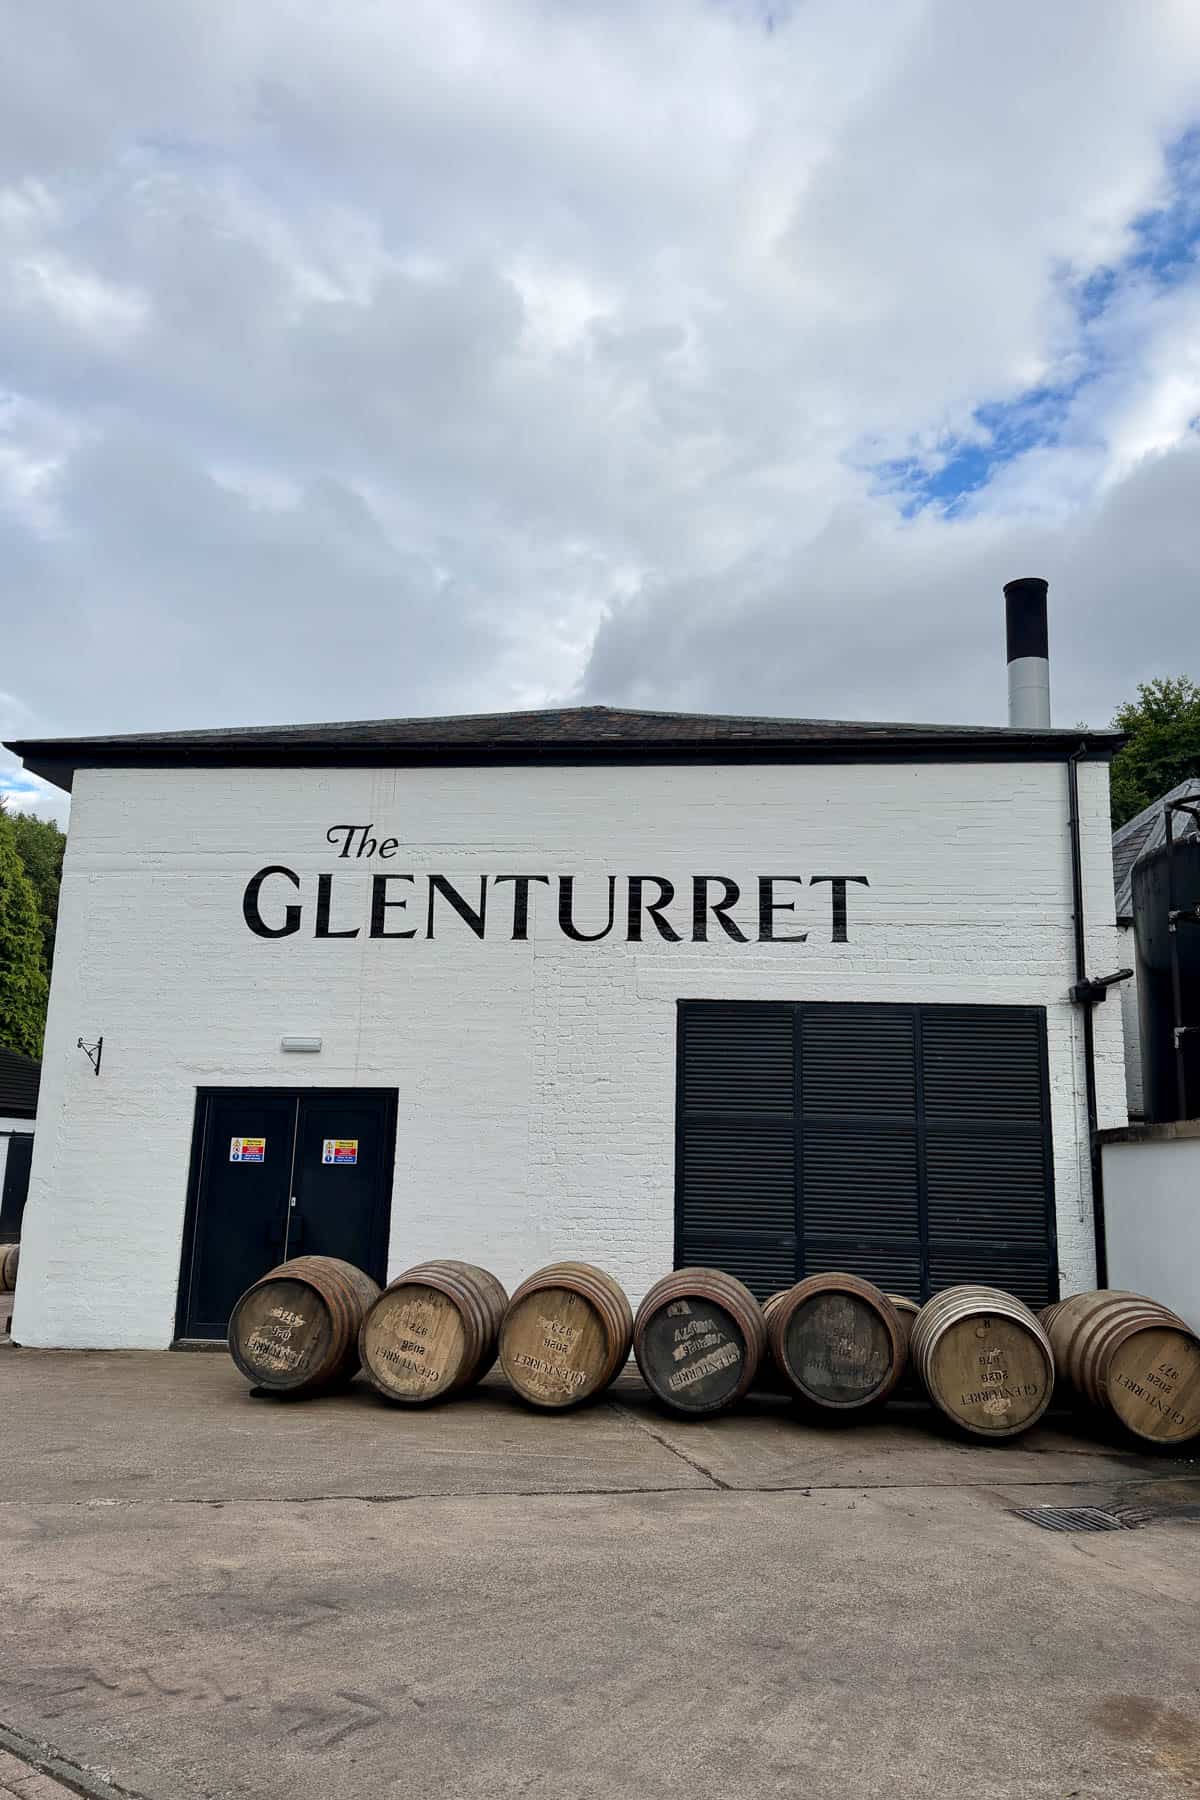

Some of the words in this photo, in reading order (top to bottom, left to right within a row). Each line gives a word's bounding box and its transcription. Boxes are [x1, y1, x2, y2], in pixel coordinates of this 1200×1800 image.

[327, 824, 398, 858] The
[243, 866, 869, 943] GLENTURRET
[408, 1323, 428, 1337] 972
[542, 1338, 569, 1354] 2026
[375, 1346, 439, 1382] GLENTURRET
[513, 1352, 584, 1385] GLENTURRET
[670, 1351, 738, 1387] GLENTURRET
[980, 1370, 1009, 1383] 2026
[1157, 1363, 1180, 1380] 977
[960, 1383, 1038, 1406] GLENTURRET
[1145, 1372, 1173, 1394] 2026
[1113, 1373, 1185, 1425] GLENTURRET
